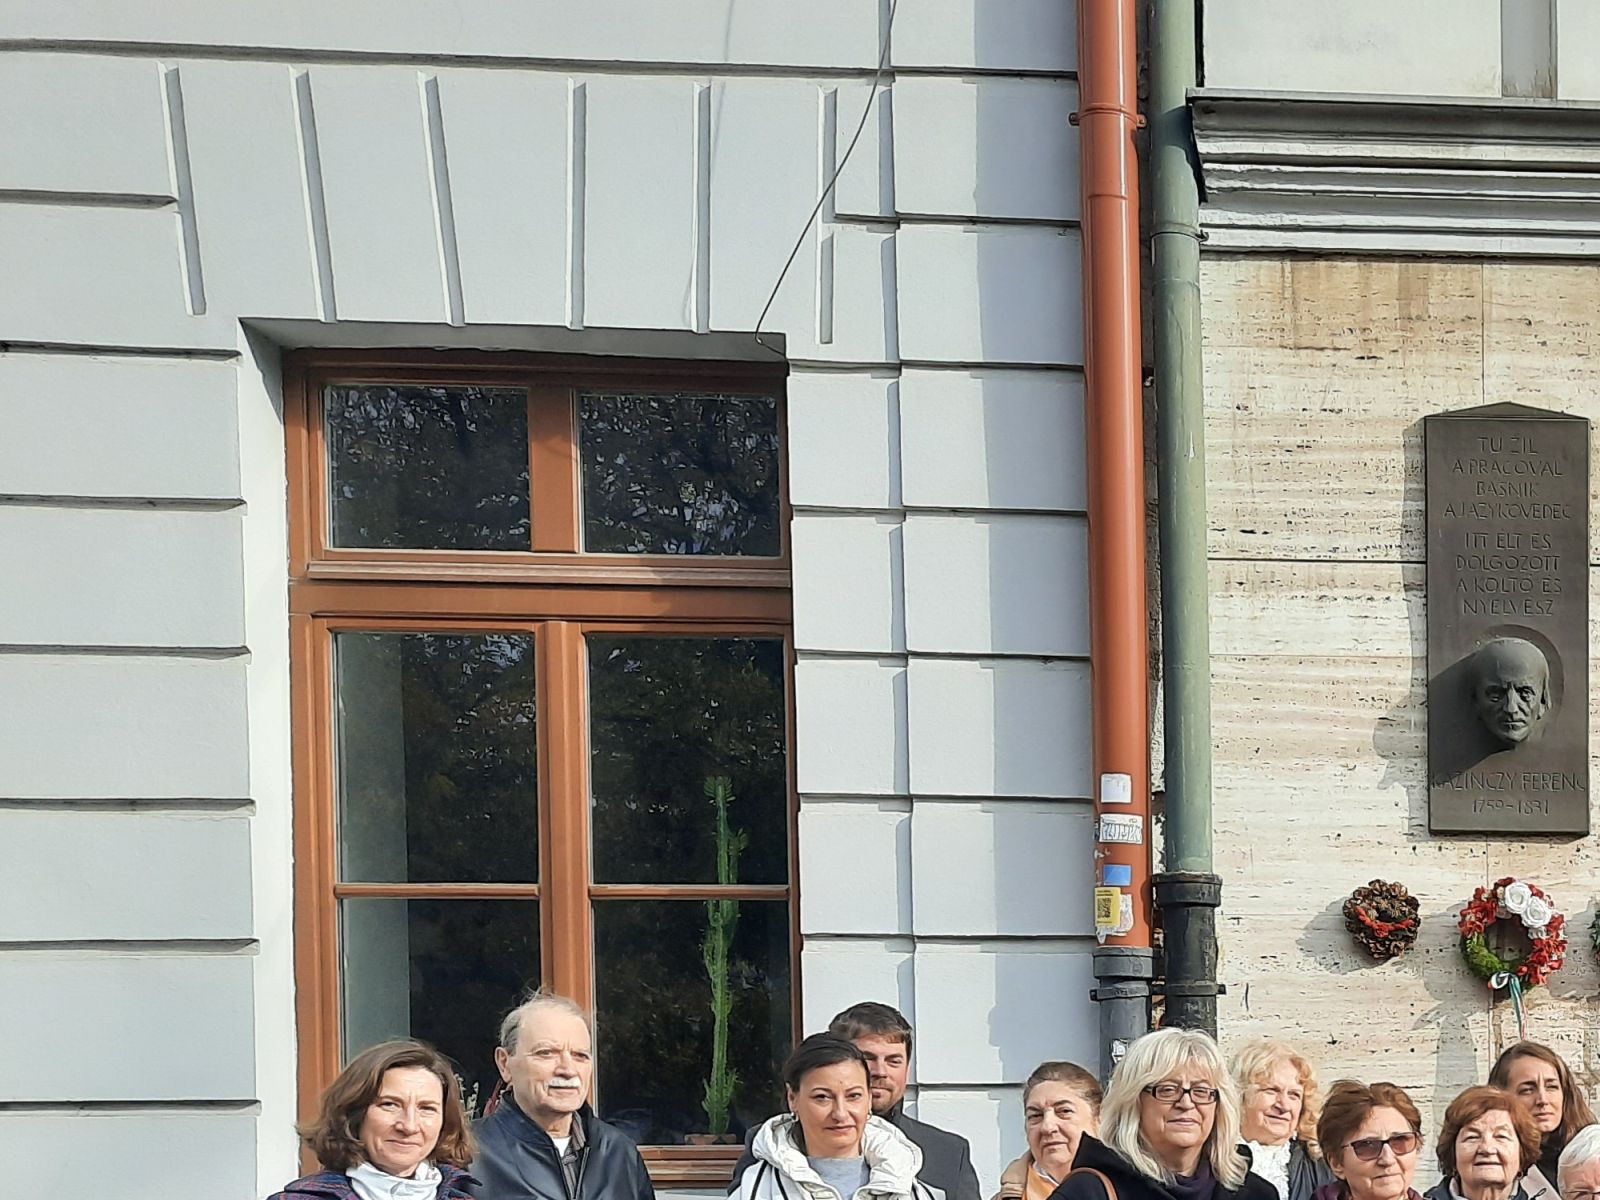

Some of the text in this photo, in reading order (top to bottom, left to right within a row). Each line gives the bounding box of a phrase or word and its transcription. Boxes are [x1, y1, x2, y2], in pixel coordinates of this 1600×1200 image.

[1477, 436, 1502, 454] TU
[1453, 459, 1565, 477] A PRACOVAL
[1443, 503, 1457, 519] A
[1465, 532, 1488, 549] ITT
[1456, 554, 1560, 572] DOLGOZOTT
[1456, 578, 1468, 593] A
[1522, 771, 1586, 793] FERENC
